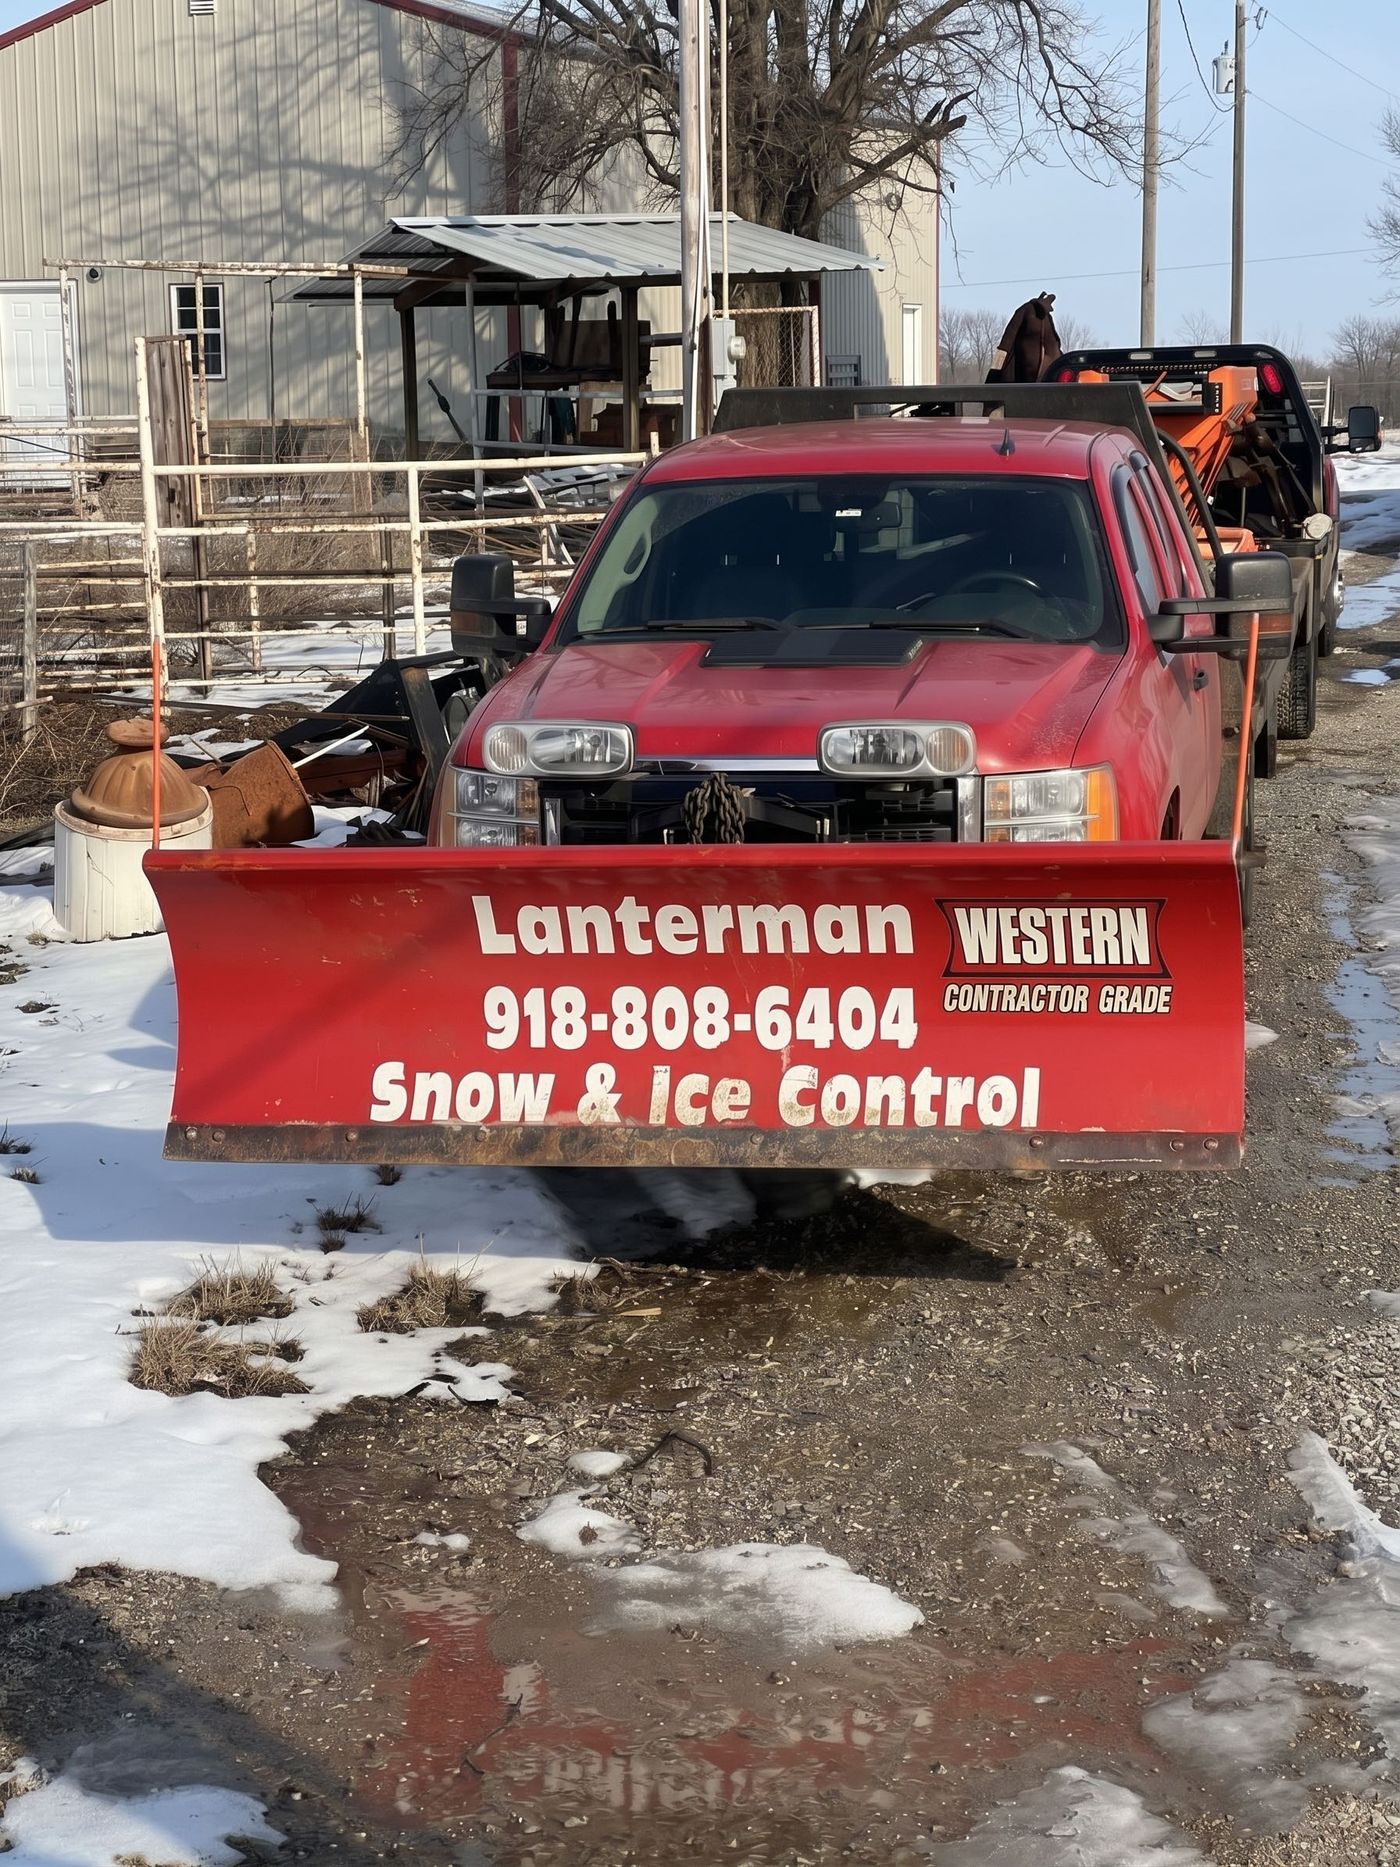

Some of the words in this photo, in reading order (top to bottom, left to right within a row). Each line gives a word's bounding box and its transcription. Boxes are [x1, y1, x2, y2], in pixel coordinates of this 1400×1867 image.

[472, 894, 914, 956] Lanterman
[953, 906, 1152, 966] WESTERN
[483, 985, 919, 1051] 918-808-6404
[942, 983, 1089, 1014] CONTRACTOR
[1097, 984, 1173, 1015] GRADE
[369, 1061, 556, 1123] Snow
[576, 1062, 623, 1126] &
[649, 1065, 752, 1127] Ice
[777, 1065, 1041, 1129] Control
